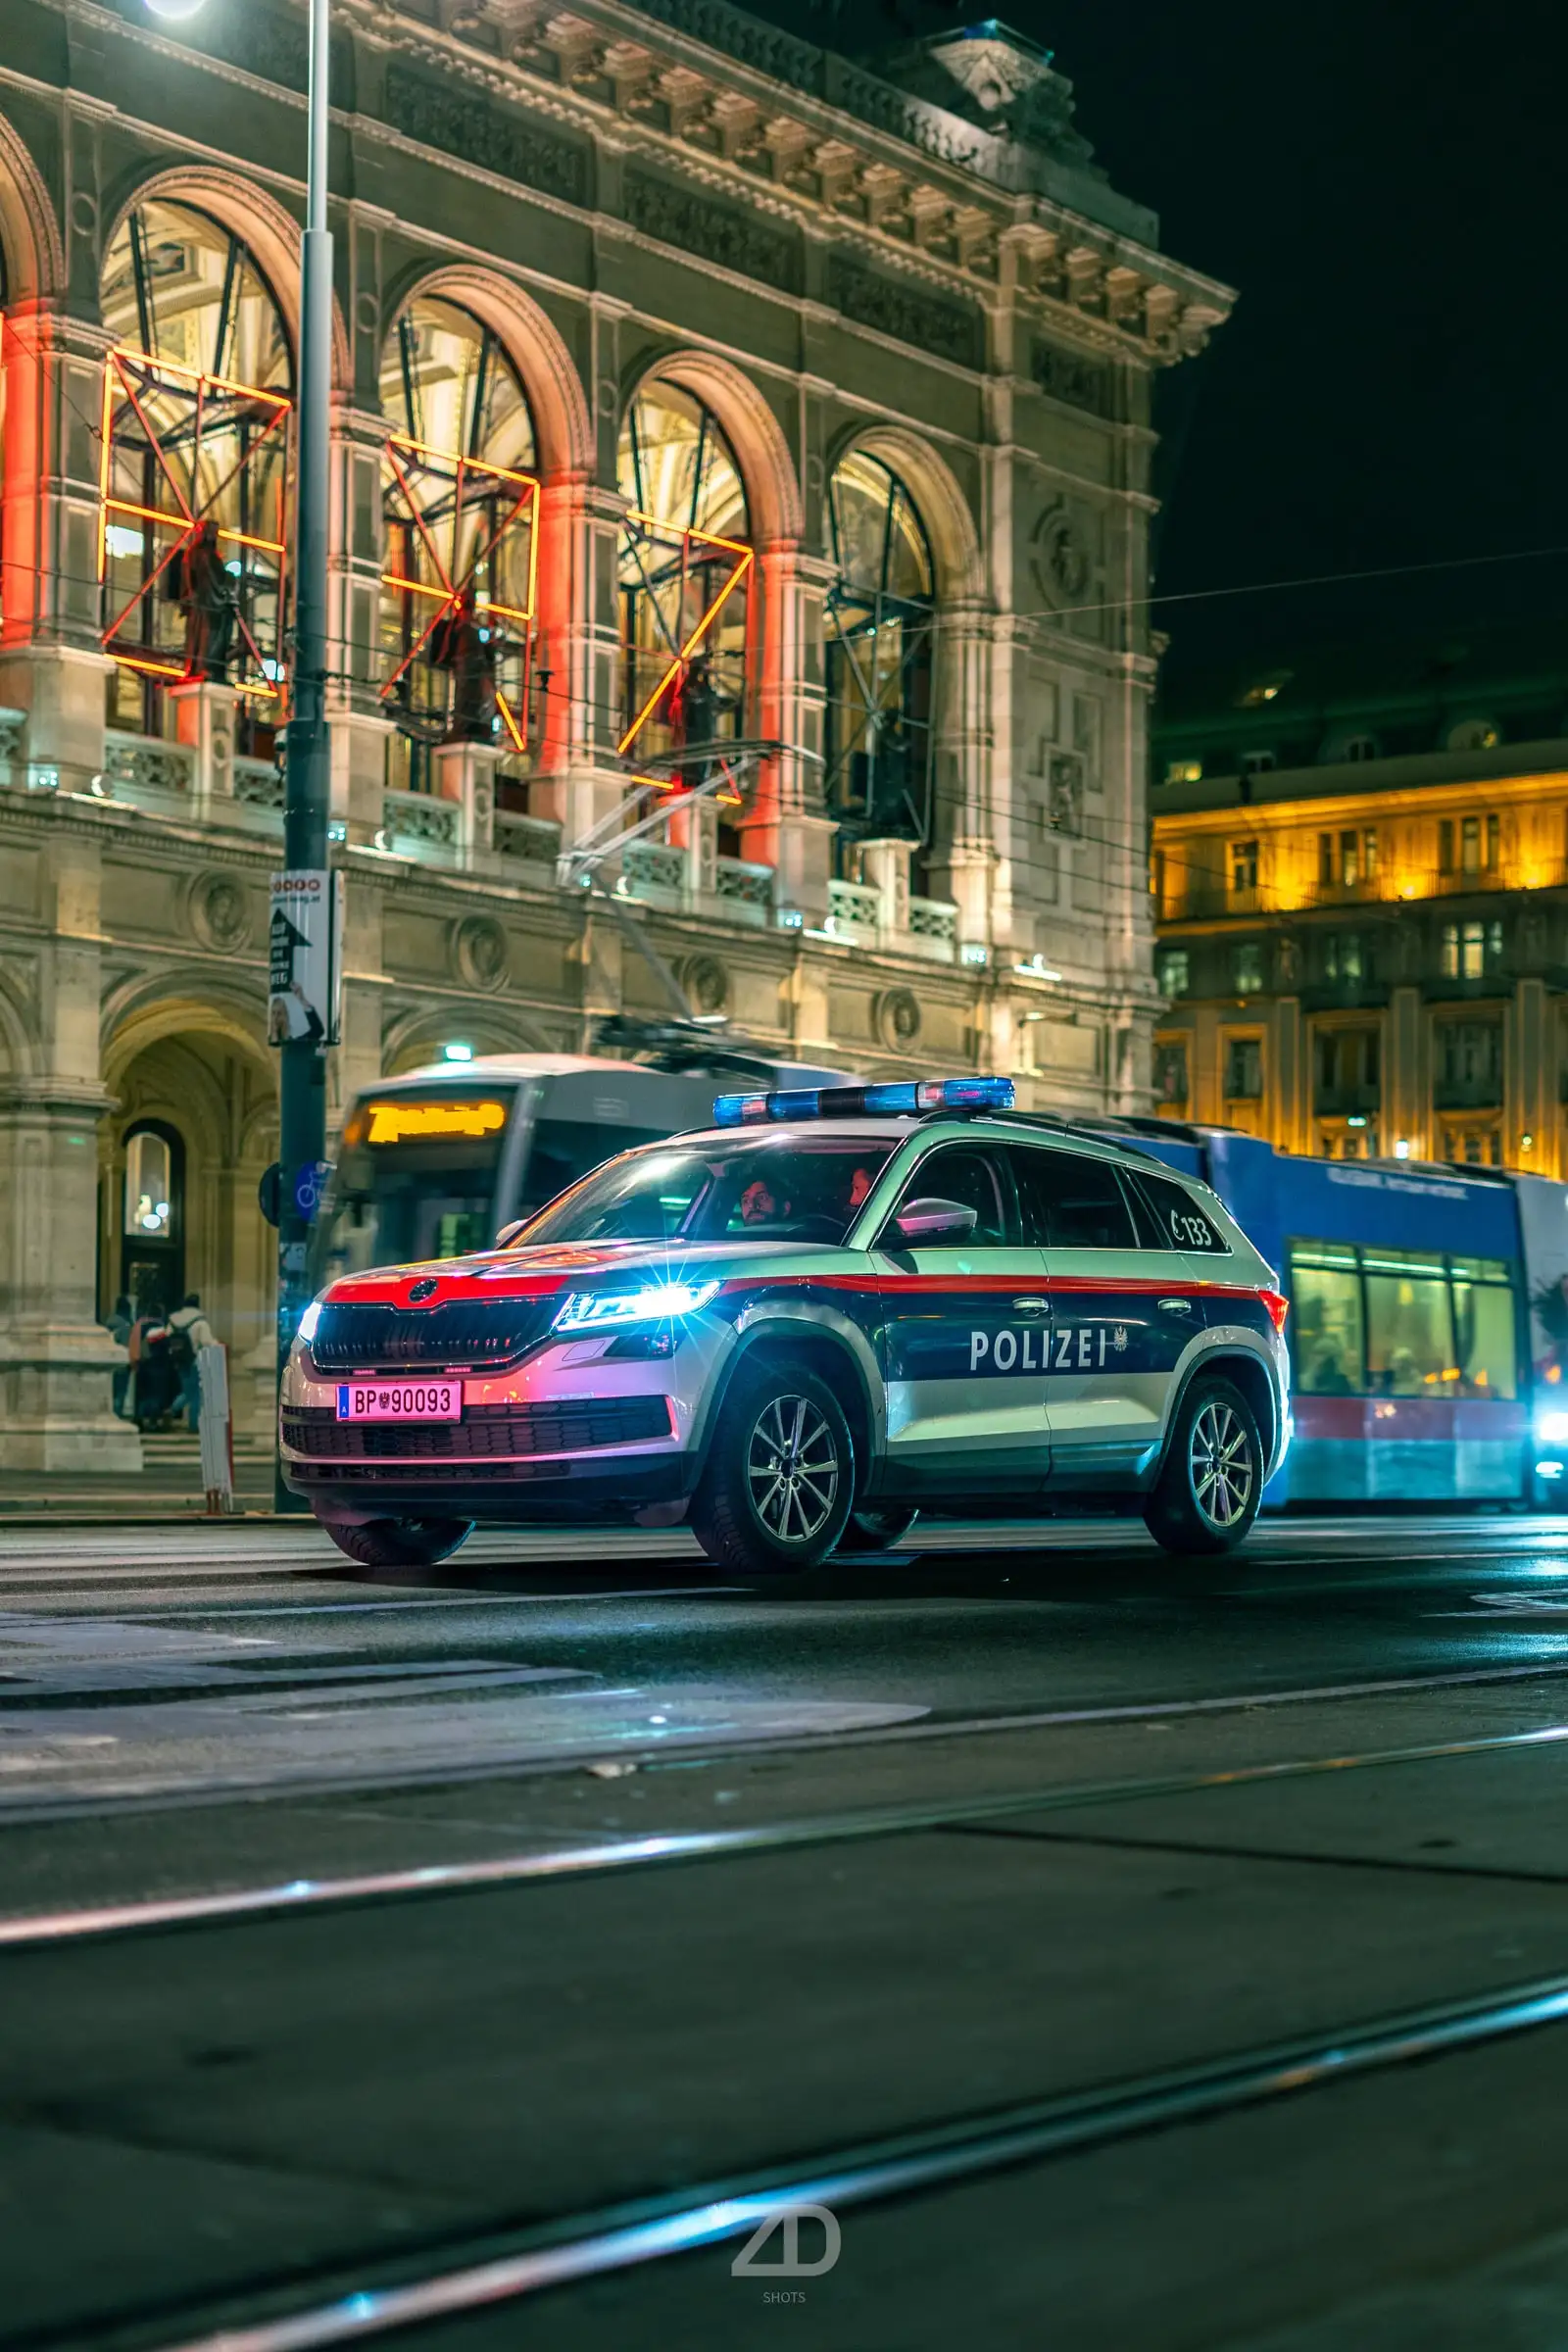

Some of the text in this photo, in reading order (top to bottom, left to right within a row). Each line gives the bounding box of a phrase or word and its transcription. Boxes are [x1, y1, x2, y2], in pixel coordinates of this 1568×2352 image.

[970, 1329, 1105, 1371] POLIZEI
[355, 1388, 451, 1413] BP 90093
